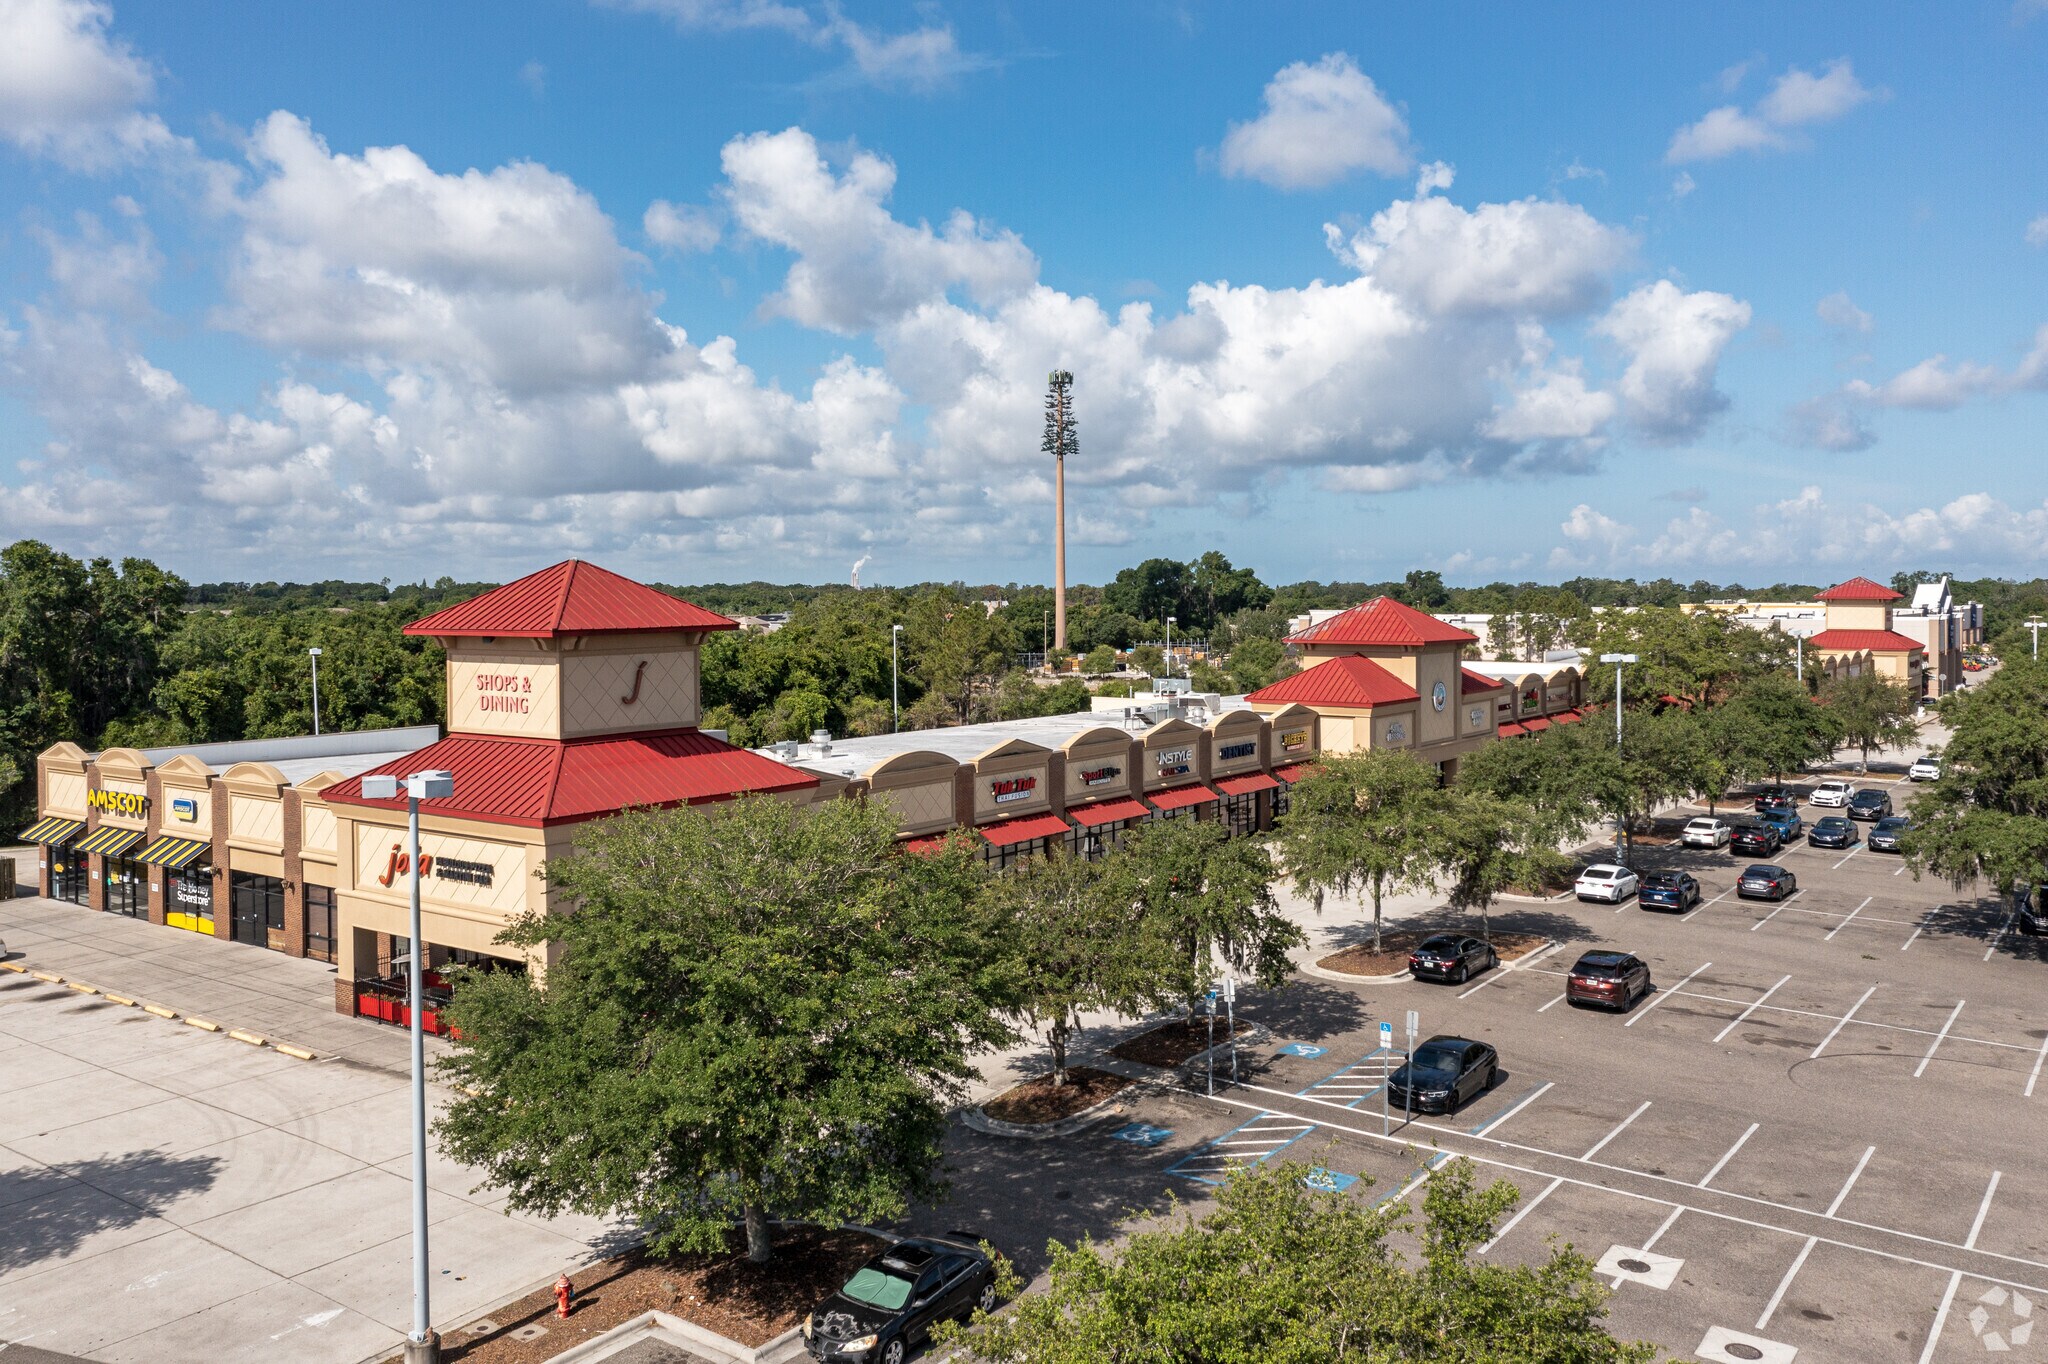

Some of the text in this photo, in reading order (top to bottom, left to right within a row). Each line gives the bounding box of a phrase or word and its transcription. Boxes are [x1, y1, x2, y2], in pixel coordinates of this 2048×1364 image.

[476, 674, 531, 693] SHOPS &
[479, 695, 529, 714] DINING
[1158, 749, 1192, 765] INSTYLE
[1221, 743, 1256, 760] DENTIST
[993, 776, 1037, 796] Tuk Tuk
[88, 788, 144, 814] AMSCOT
[379, 844, 431, 885] joa
